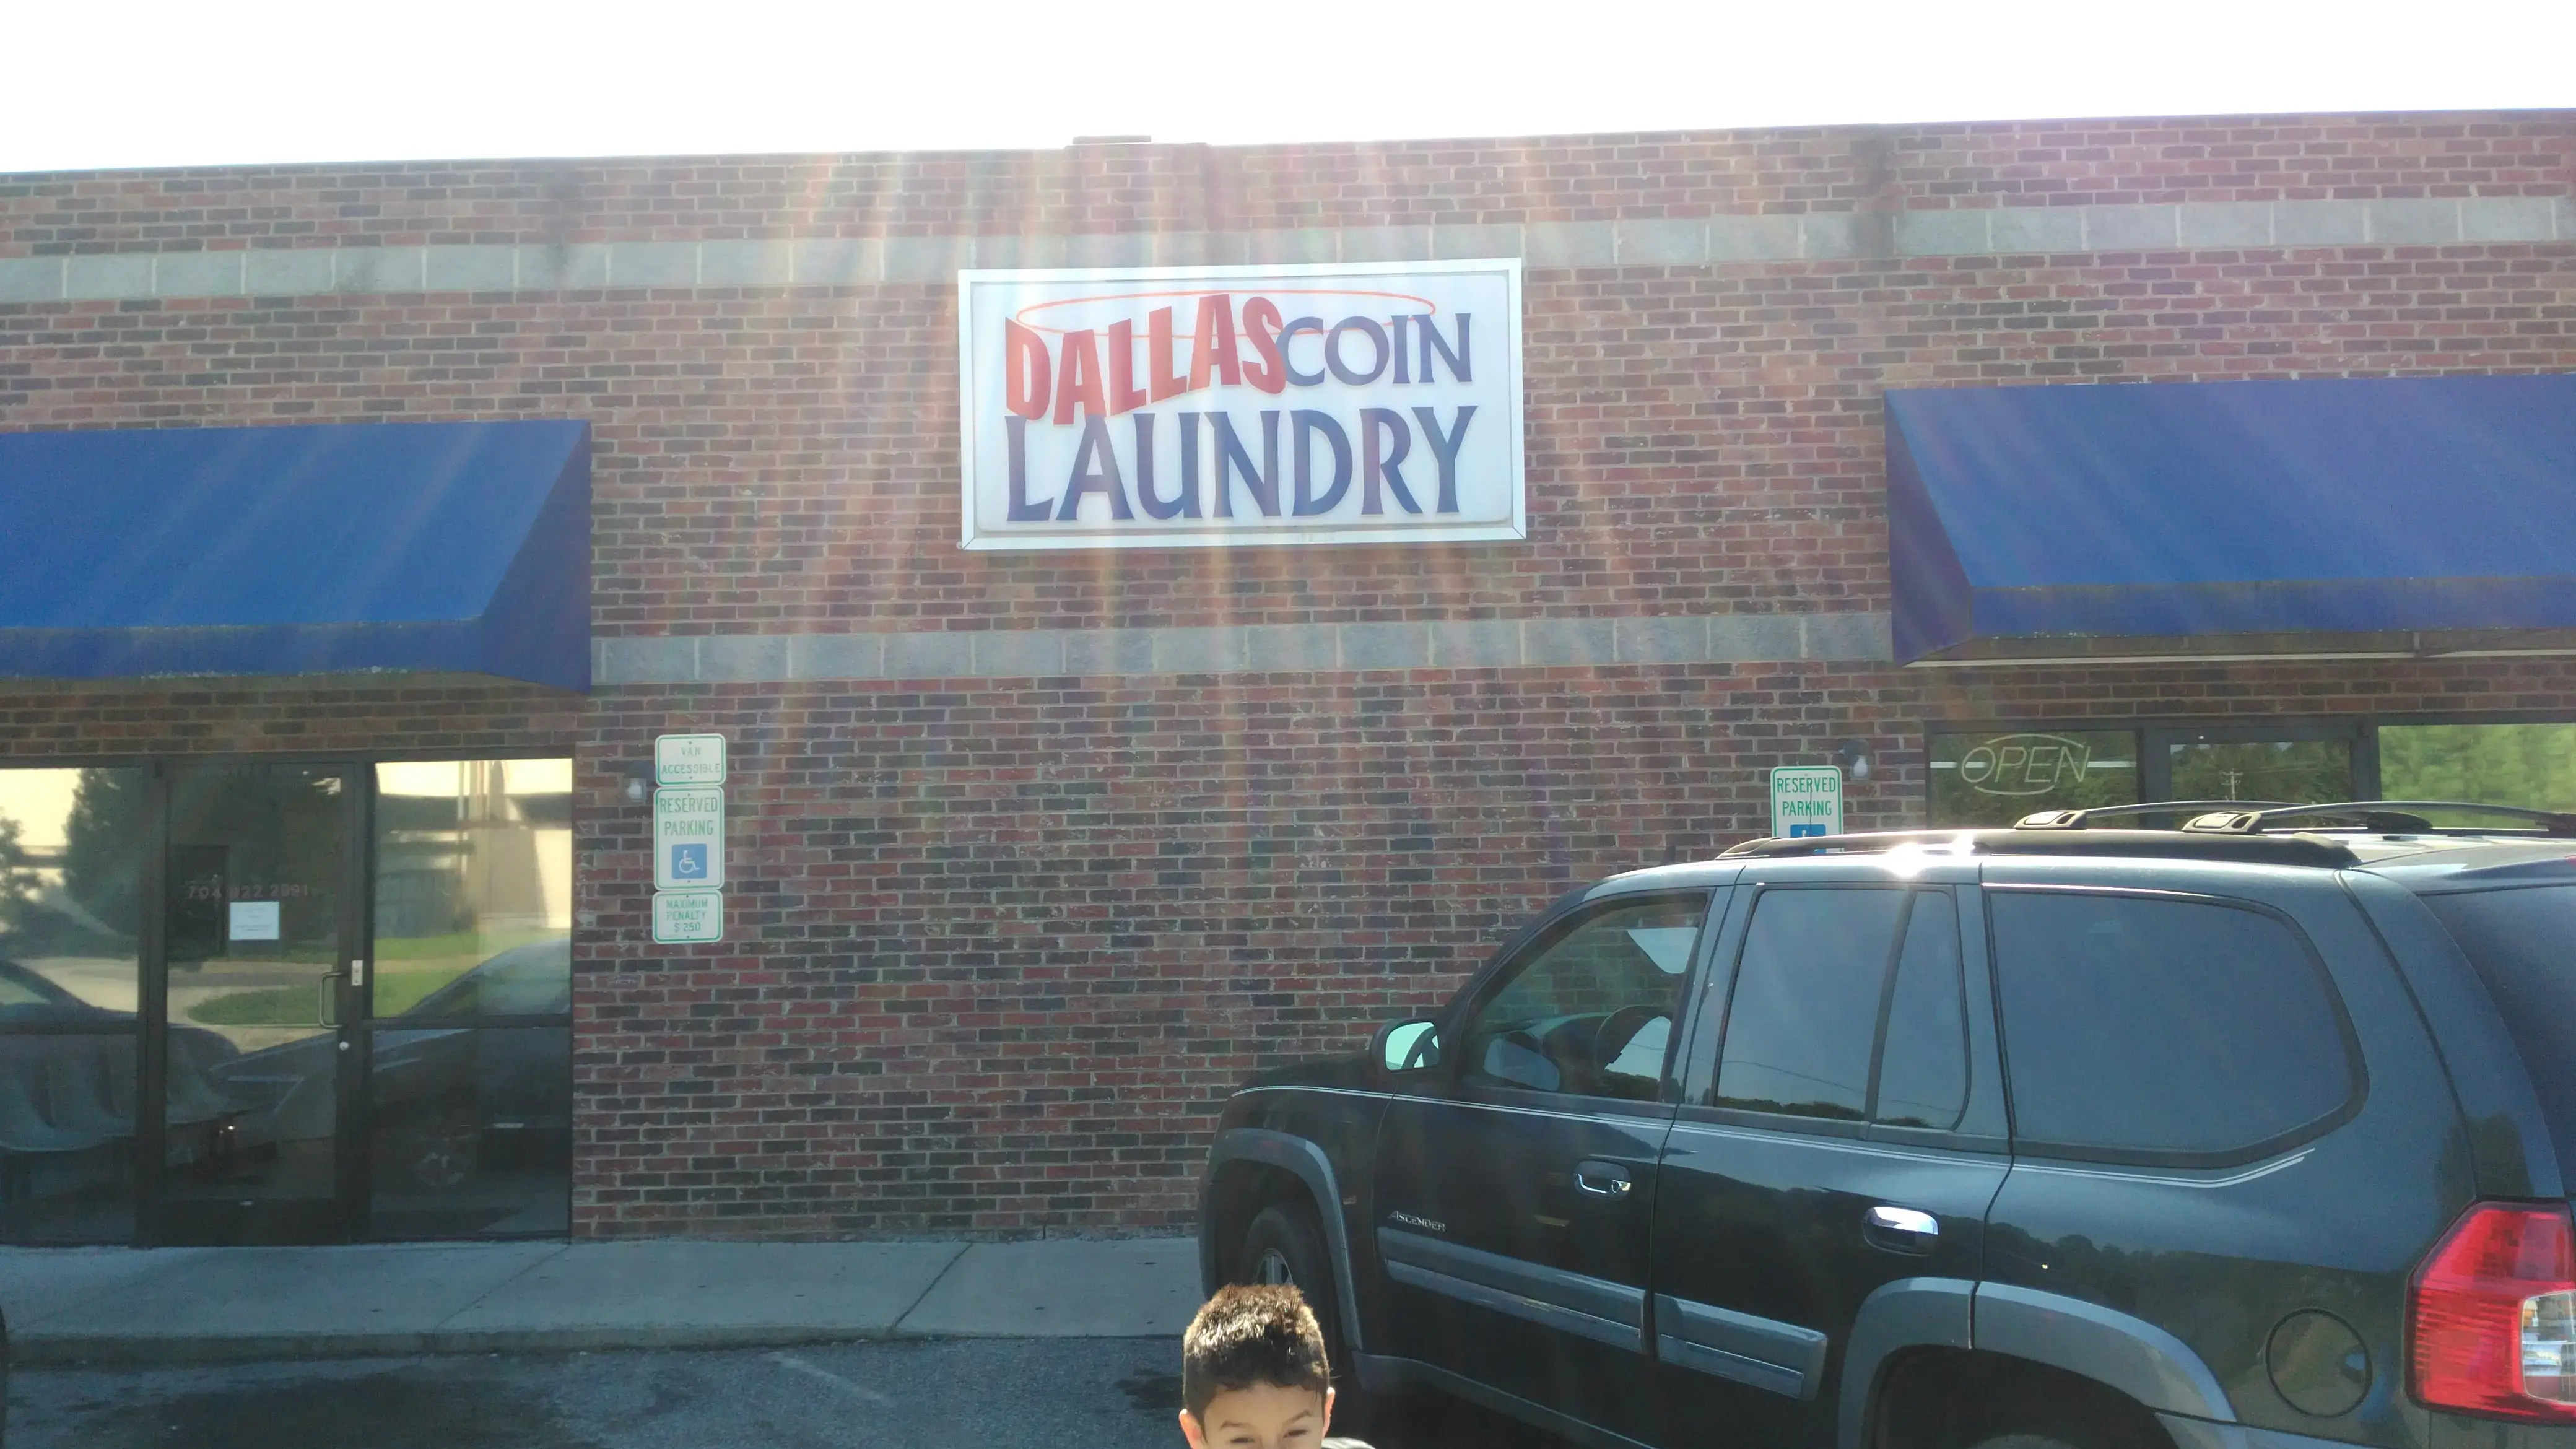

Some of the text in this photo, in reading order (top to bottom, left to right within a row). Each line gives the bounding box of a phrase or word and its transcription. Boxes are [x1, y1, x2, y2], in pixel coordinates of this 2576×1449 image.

[1005, 294, 1473, 425] DALLAS COIN
[1005, 405, 1478, 521] LAUNDRY
[681, 747, 701, 756] VAN
[662, 764, 721, 775] ACCESSIBLE
[1961, 746, 2091, 783] OPEN
[1777, 777, 1836, 793] RESERVED
[659, 797, 718, 814] RESERVED
[1782, 801, 1832, 816] PARKING
[664, 820, 714, 836] PARKING
[666, 899, 708, 909] MAXIMUM
[667, 910, 706, 921] PENALTY
[1388, 1210, 1446, 1232] ASCENDER
